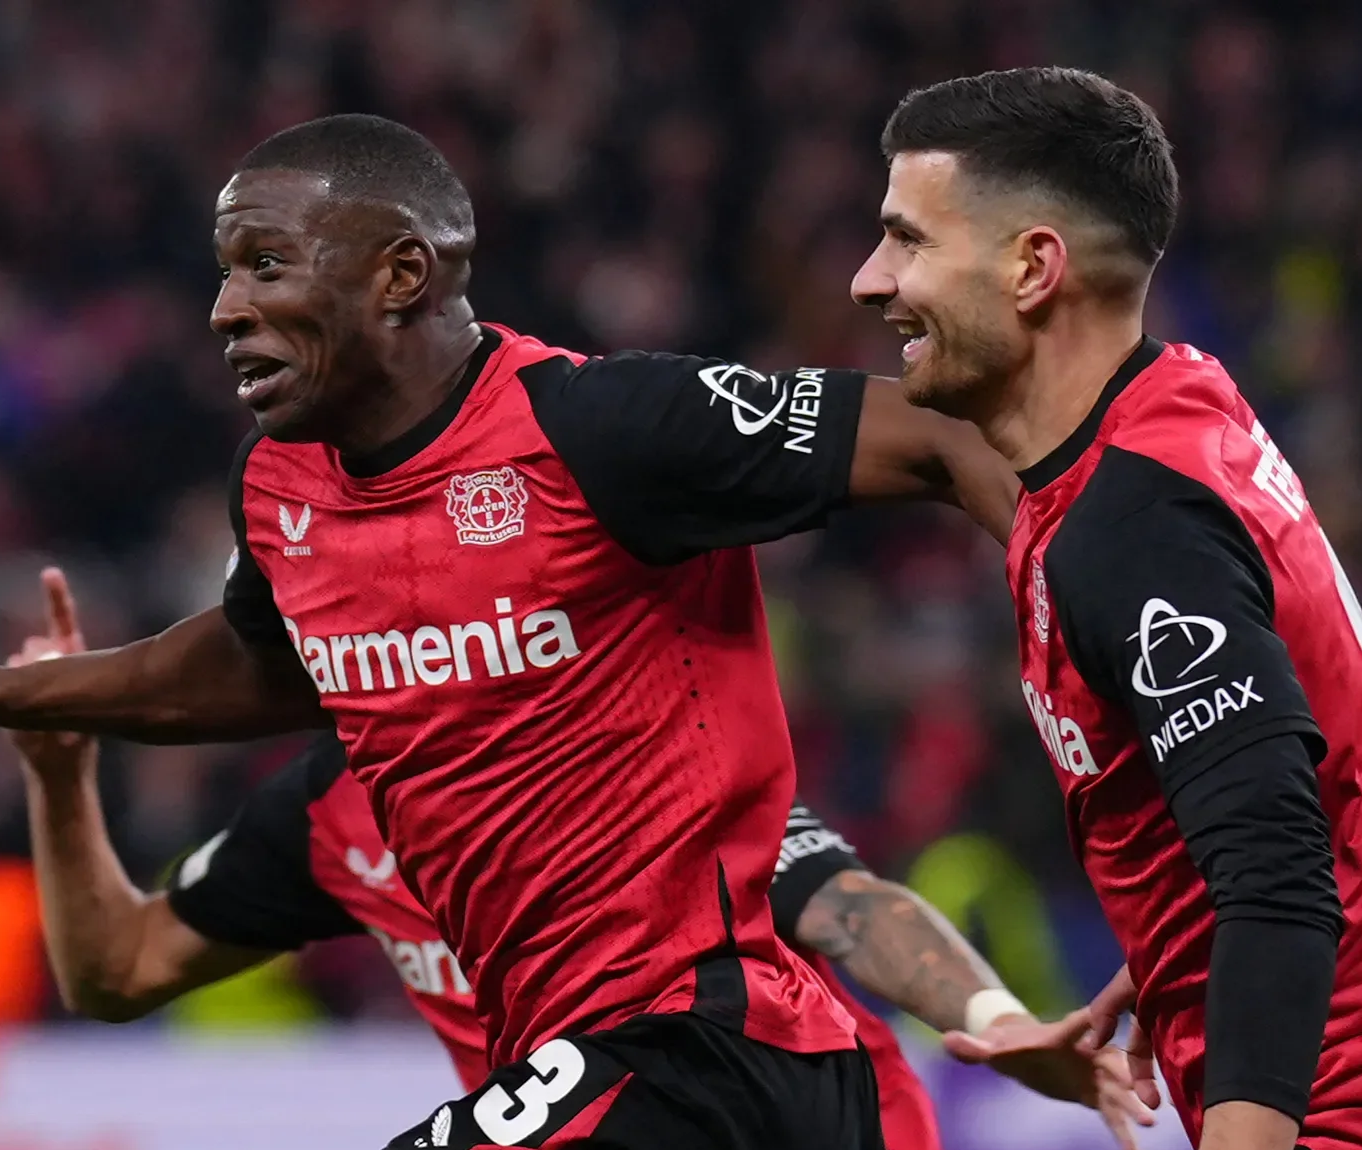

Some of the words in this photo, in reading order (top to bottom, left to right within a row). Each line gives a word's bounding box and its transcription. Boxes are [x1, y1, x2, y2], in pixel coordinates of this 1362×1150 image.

[784, 366, 826, 454] NIEDA
[462, 525, 519, 541] Leverkusen
[471, 501, 505, 515] BAYER
[1150, 675, 1264, 762] NIEDAX
[473, 1038, 585, 1147] 3
